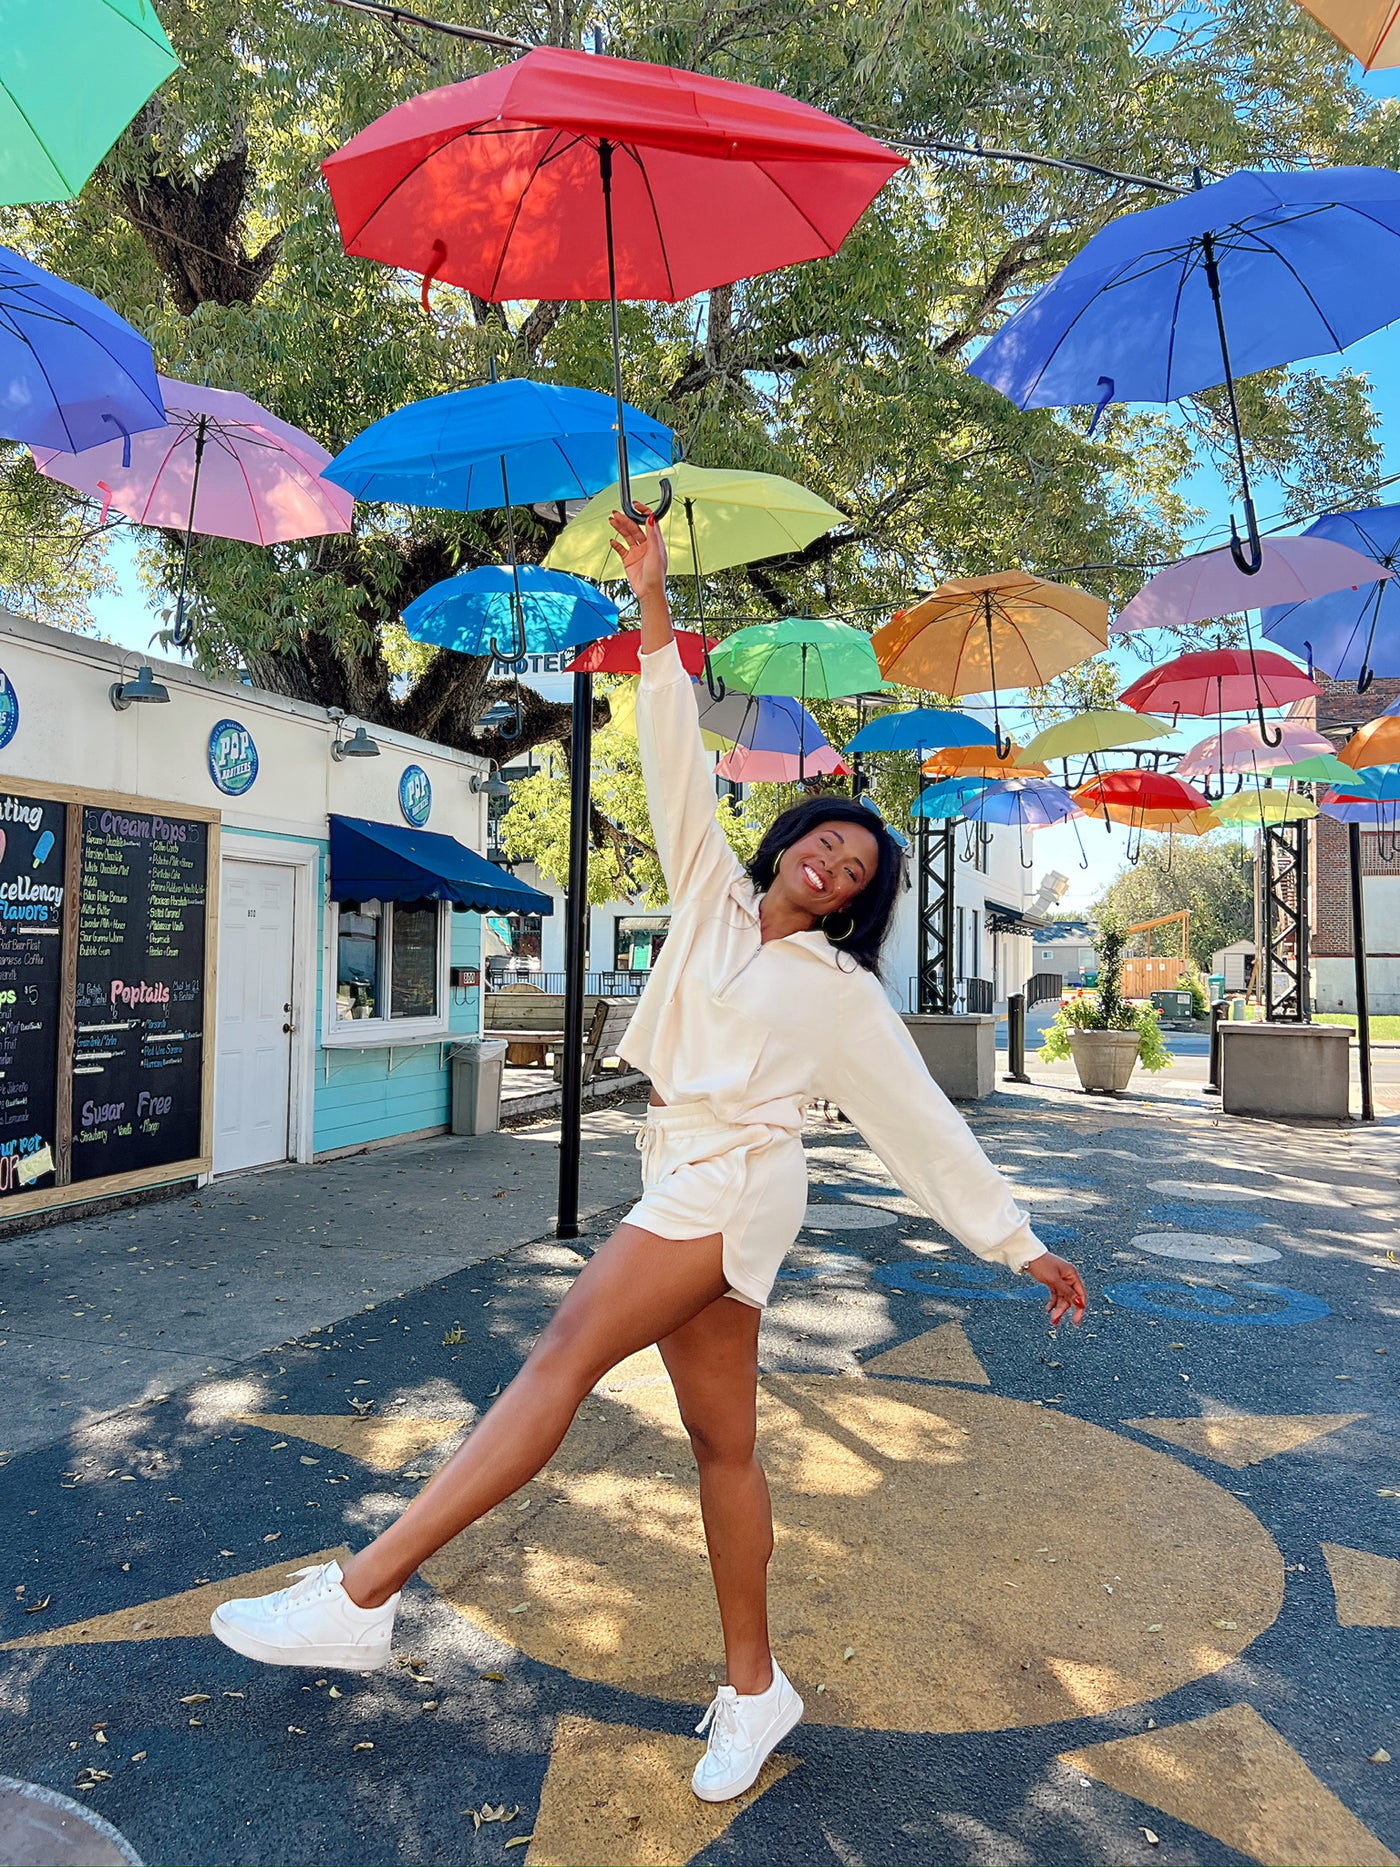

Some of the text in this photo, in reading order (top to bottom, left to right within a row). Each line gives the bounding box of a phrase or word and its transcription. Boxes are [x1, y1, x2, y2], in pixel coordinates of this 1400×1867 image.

[219, 731, 249, 766] POP
[408, 772, 426, 806] POP
[100, 810, 187, 842] Cream Pops
[79, 943, 98, 957] Bubble
[110, 979, 170, 1010] Poptails
[81, 1091, 172, 1126] Sugar Free
[19, 1133, 42, 1153] pet
